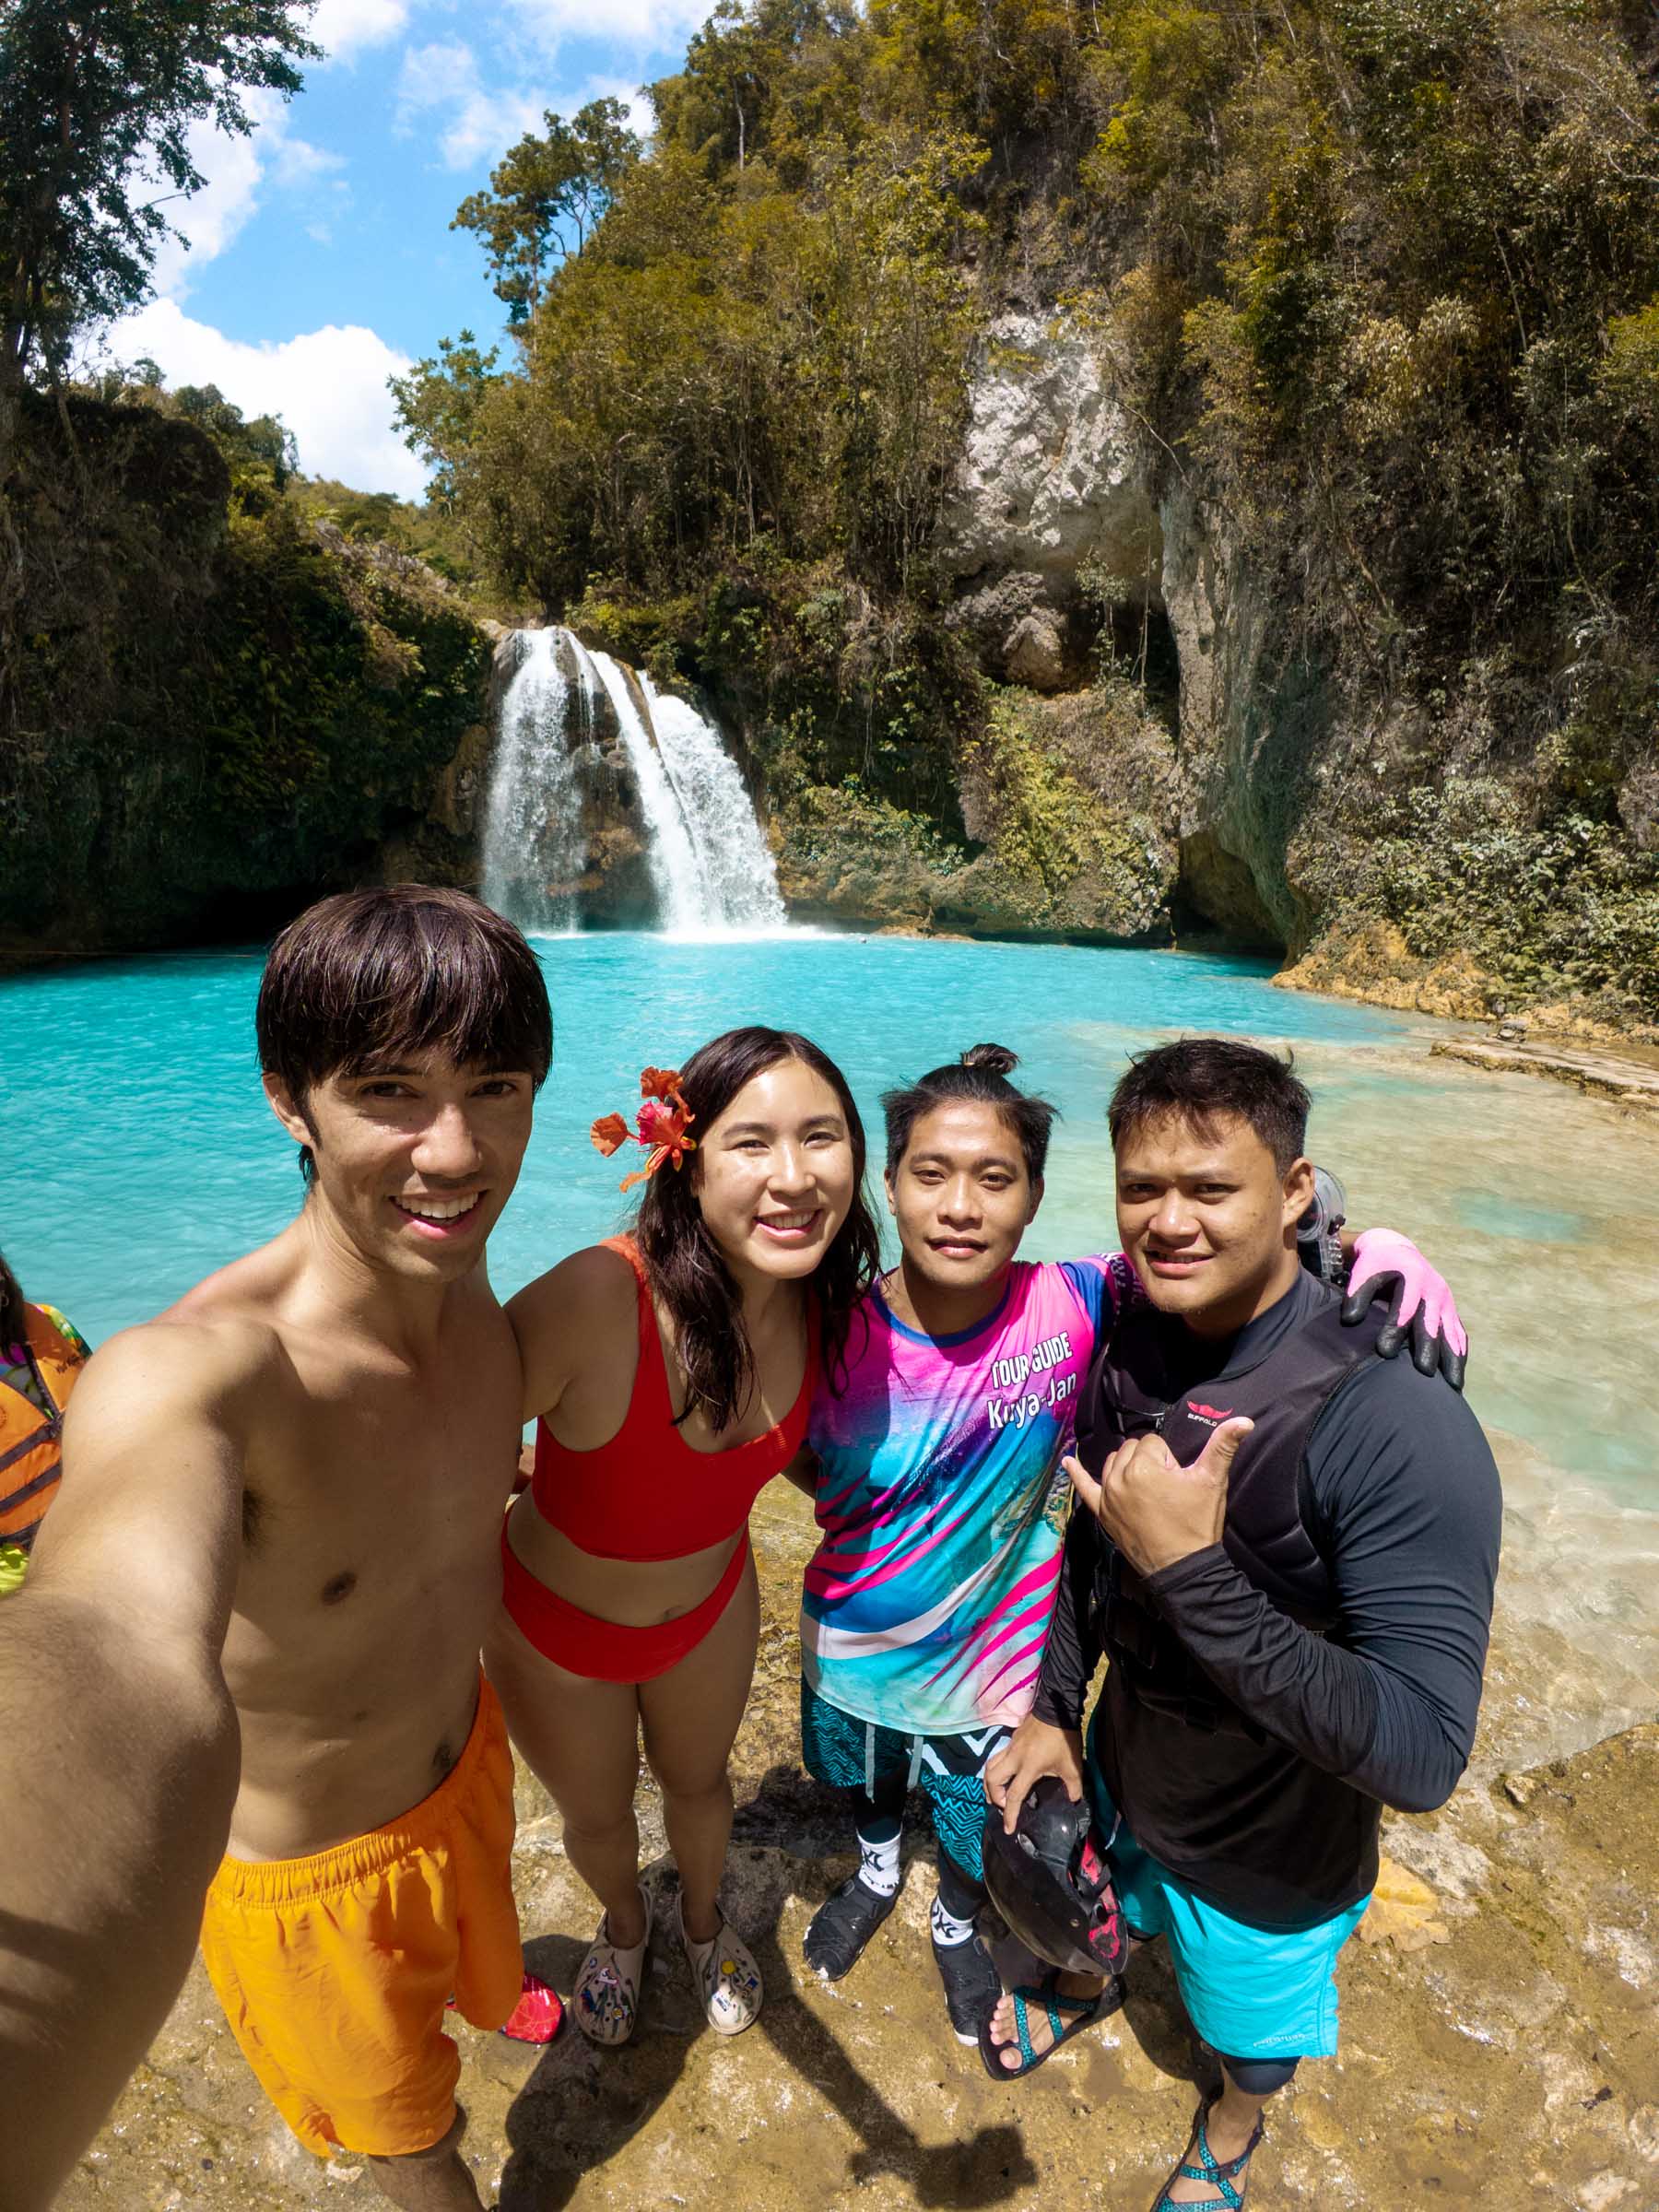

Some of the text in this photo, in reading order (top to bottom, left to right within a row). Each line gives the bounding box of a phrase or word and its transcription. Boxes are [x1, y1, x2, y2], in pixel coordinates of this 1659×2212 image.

[991, 1331, 1073, 1389] TOUR GUIDE
[987, 1371, 1077, 1430] Kuya-Jan
[1187, 1412, 1218, 1428] BUFFALO
